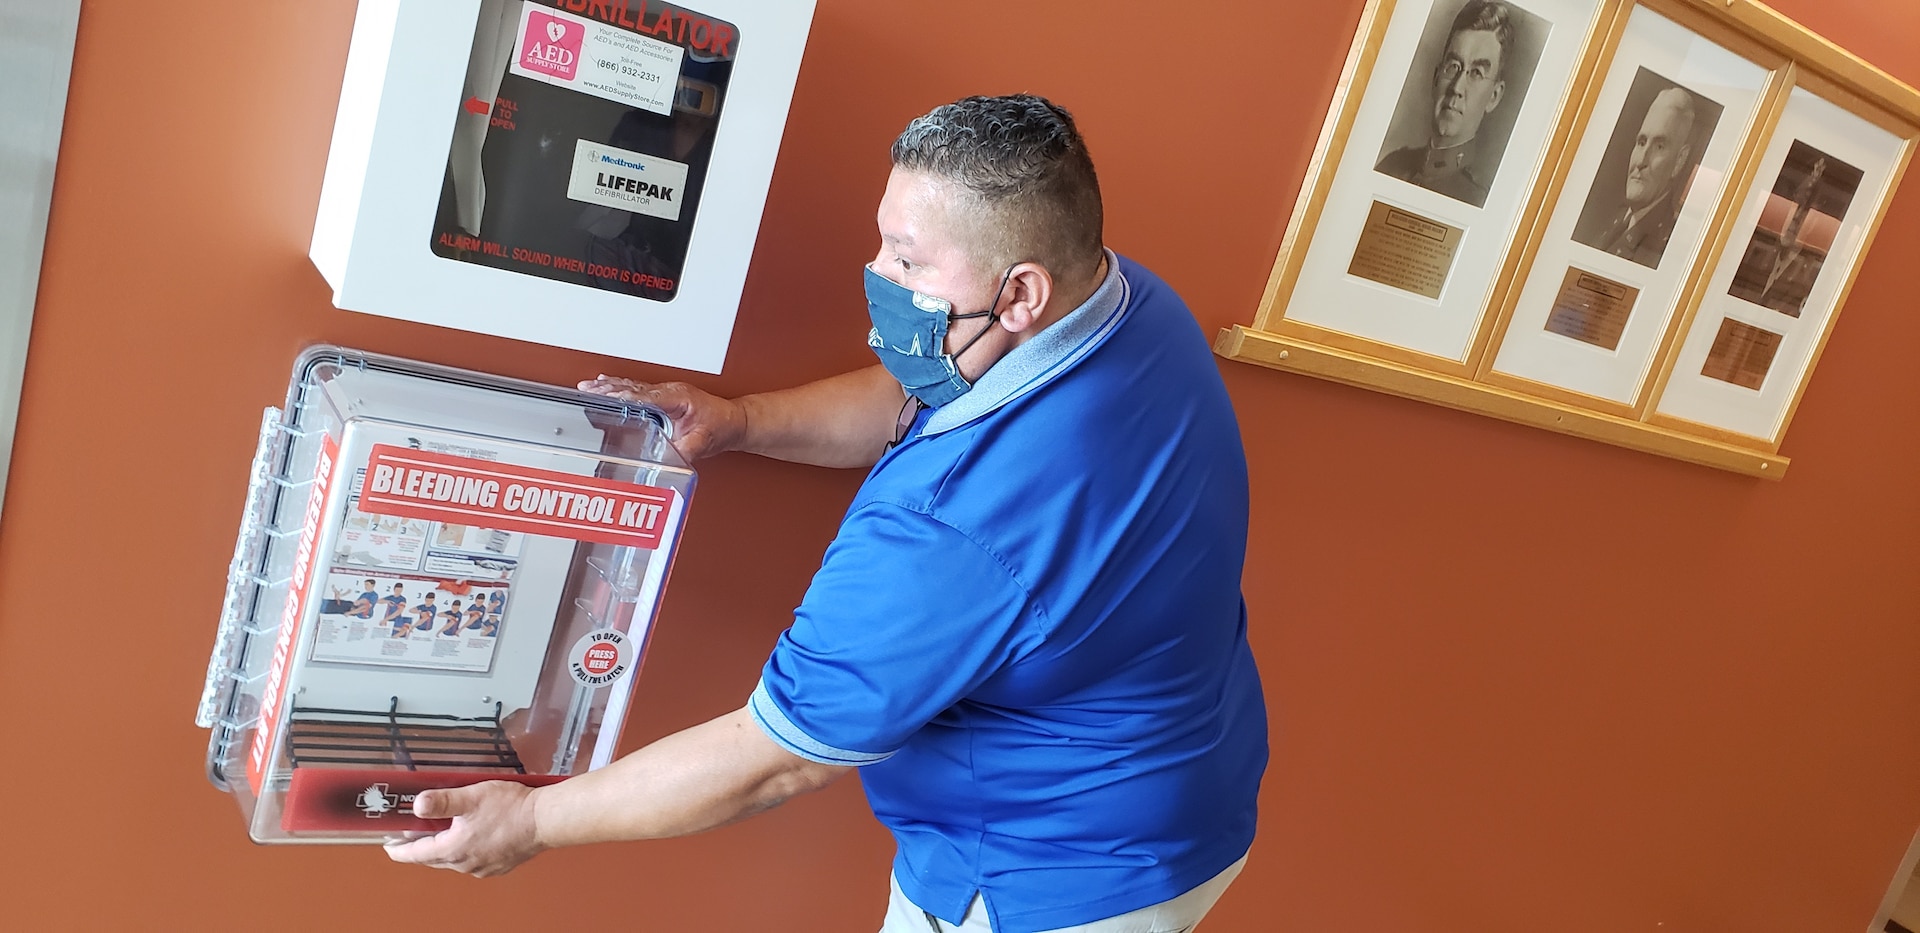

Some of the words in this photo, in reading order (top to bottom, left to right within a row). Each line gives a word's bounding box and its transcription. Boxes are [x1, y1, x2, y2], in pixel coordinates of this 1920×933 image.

[557, 0, 732, 56] RILLATOR
[599, 27, 612, 36] Your
[614, 31, 640, 45] Complete
[642, 40, 663, 51] Source
[664, 46, 674, 54] For
[528, 41, 574, 66] AED
[613, 41, 625, 49] and
[626, 44, 639, 53] AED
[640, 48, 673, 63] Accessories
[526, 57, 549, 68] SUPPLY
[548, 62, 570, 74] STORE
[596, 58, 620, 73] (866)
[621, 66, 661, 83] 932-2331
[621, 56, 643, 68] Toll-Free
[583, 80, 664, 107] www.AEDSupplyStore.com
[615, 79, 636, 91] Website
[496, 97, 518, 111] PULL
[500, 109, 512, 119] TO
[491, 118, 516, 131] OPEN
[601, 155, 645, 171] Medtronic
[596, 172, 674, 201] LIFEPAK
[594, 188, 650, 205] DEFIBRILLATOR
[439, 232, 480, 252] ALARM
[483, 242, 509, 258] WILL
[512, 247, 552, 266] SOUND
[553, 257, 586, 273] WHEN
[587, 264, 618, 280] DOOR
[620, 270, 630, 283] IS
[632, 275, 674, 291] OPENED
[370, 463, 500, 509] BLEEDING
[502, 483, 616, 525] CONTROL
[618, 500, 663, 530] KIT
[294, 455, 331, 588] BLEEDING
[372, 523, 378, 531] 2
[591, 634, 602, 642] TO
[603, 633, 623, 644] OPEN
[263, 589, 299, 717] CONTROL
[589, 649, 615, 660] PRESS
[589, 660, 610, 669] HERE
[574, 668, 588, 682] PULL
[588, 676, 602, 684] THE
[603, 665, 625, 682] LATCH
[252, 721, 268, 773] KIT
